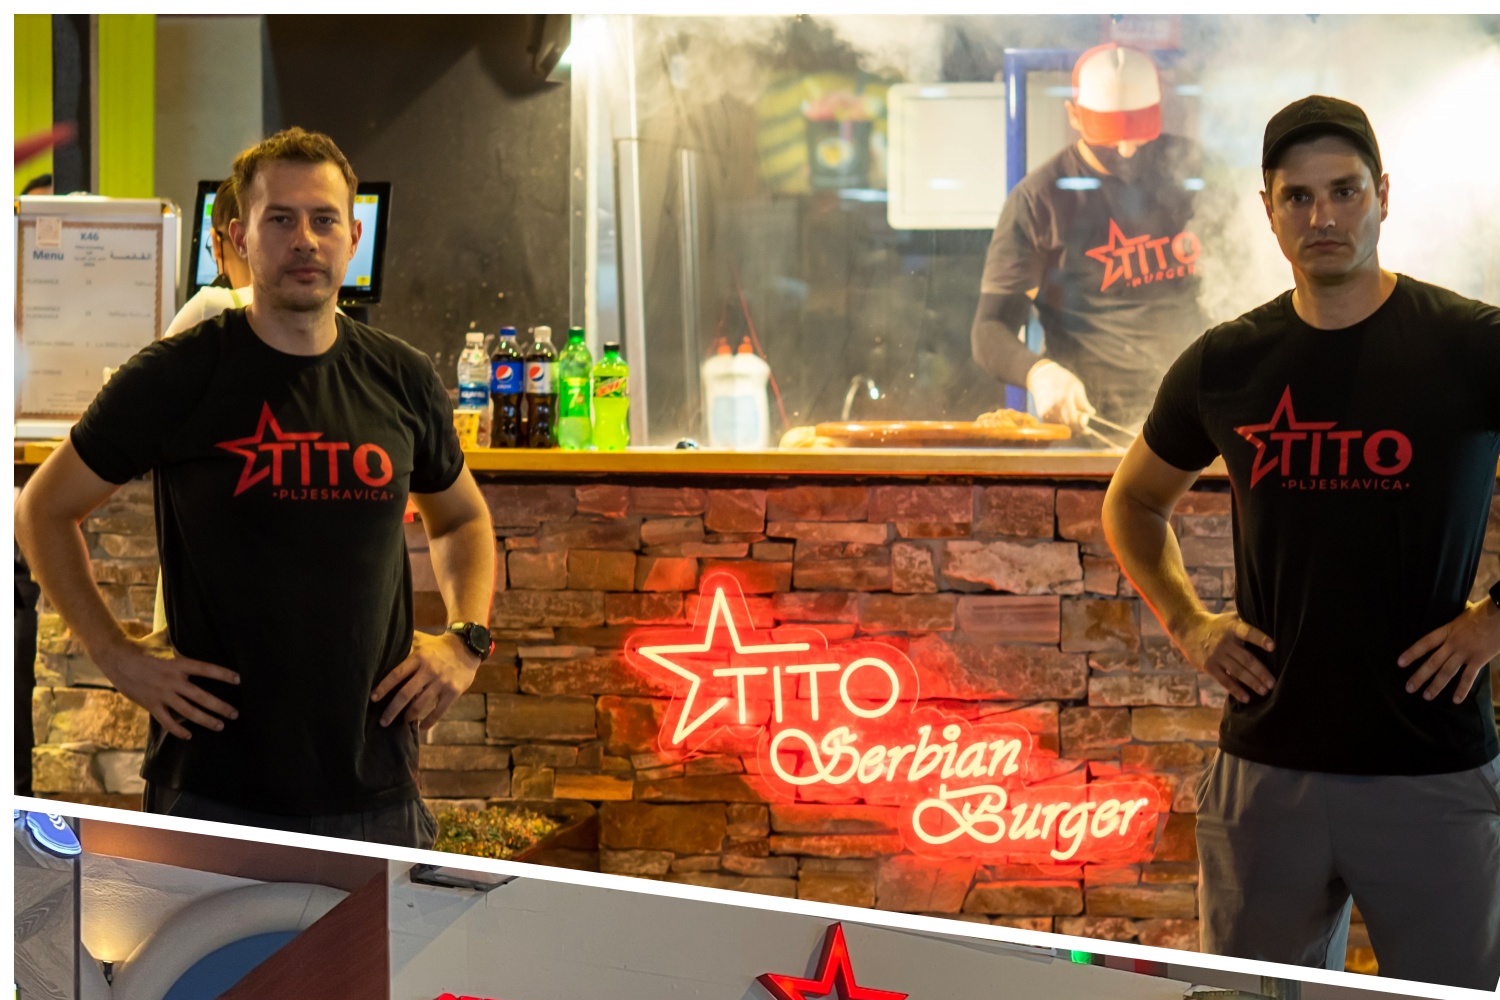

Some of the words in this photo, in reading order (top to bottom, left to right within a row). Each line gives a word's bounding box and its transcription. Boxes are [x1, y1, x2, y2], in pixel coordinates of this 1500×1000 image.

[80, 232, 99, 241] K46
[33, 251, 64, 260] Menu
[1286, 479, 1406, 490] PLJESKAVICA
[278, 489, 390, 500] PLJESKAVICA
[714, 657, 899, 724] TITO
[770, 724, 1019, 786] Serbian
[912, 784, 1149, 861] Burger
